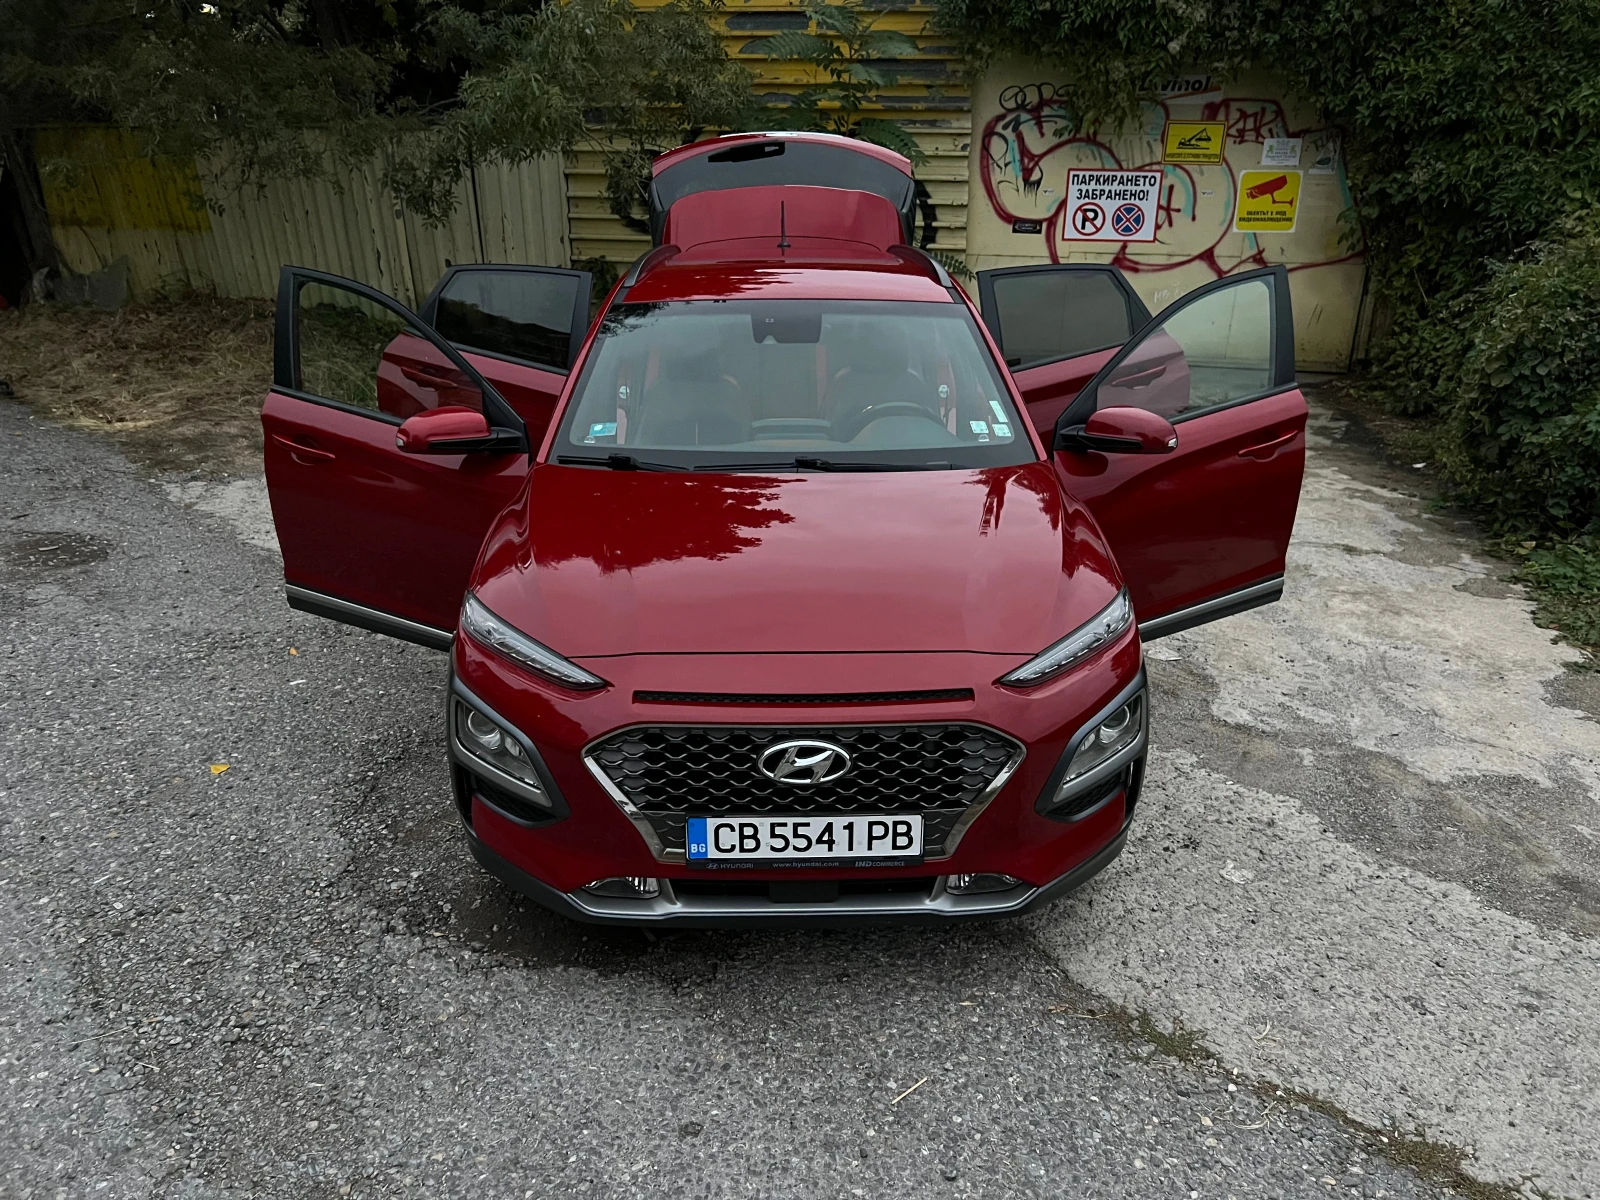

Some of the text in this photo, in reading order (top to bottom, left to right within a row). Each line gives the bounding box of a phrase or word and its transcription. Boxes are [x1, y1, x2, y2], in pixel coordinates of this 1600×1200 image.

[1071, 174, 1157, 187] ПАРКИРАНЕТО
[1076, 189, 1149, 201] ЗАБРАНЕНО!
[690, 843, 706, 853] BG
[772, 861, 840, 869] www.hyundai.com
